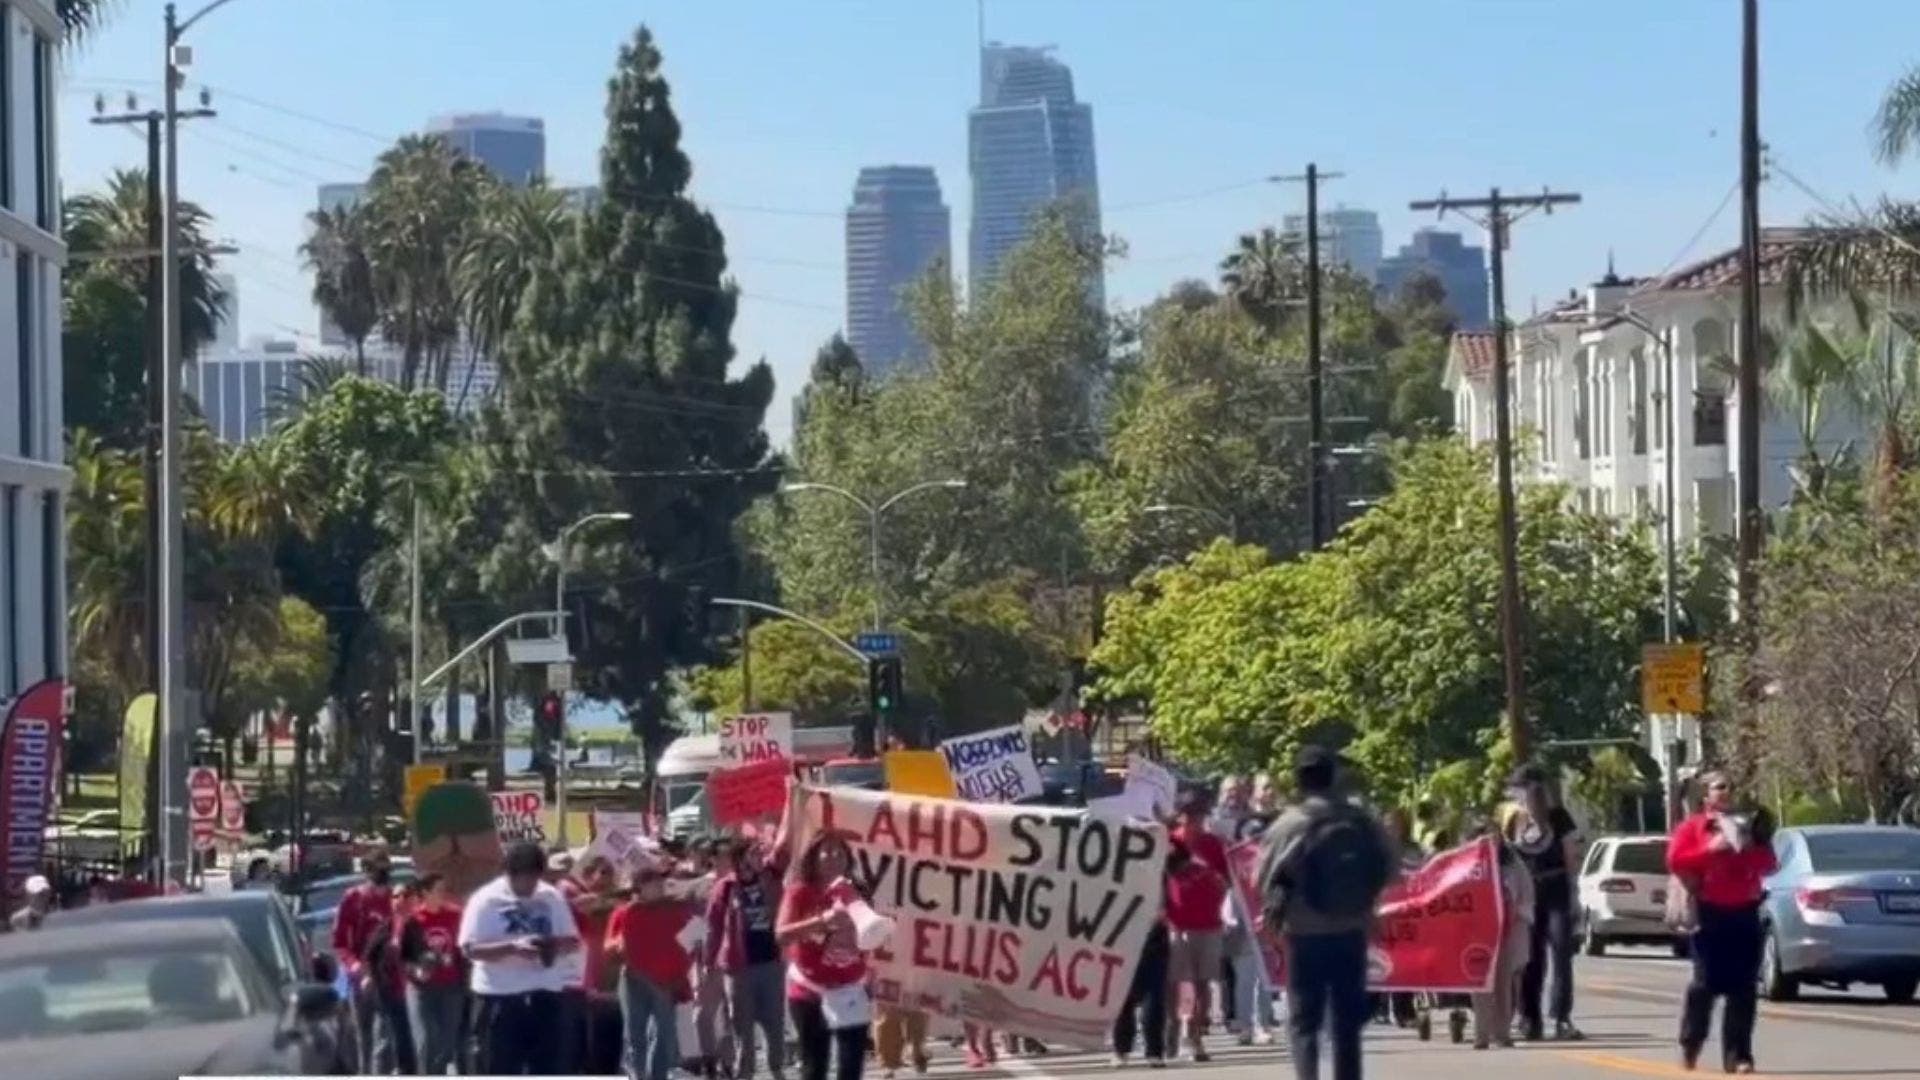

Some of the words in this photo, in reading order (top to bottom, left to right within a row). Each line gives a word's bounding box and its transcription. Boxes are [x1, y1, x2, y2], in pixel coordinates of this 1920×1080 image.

[720, 717, 769, 737] STOP
[819, 792, 988, 861] LAHD
[1009, 814, 1155, 883] STOP
[856, 848, 1054, 931] VICTING
[1067, 880, 1144, 947] W/
[912, 918, 1021, 984] ELLIS
[1028, 943, 1124, 1007] ACT
